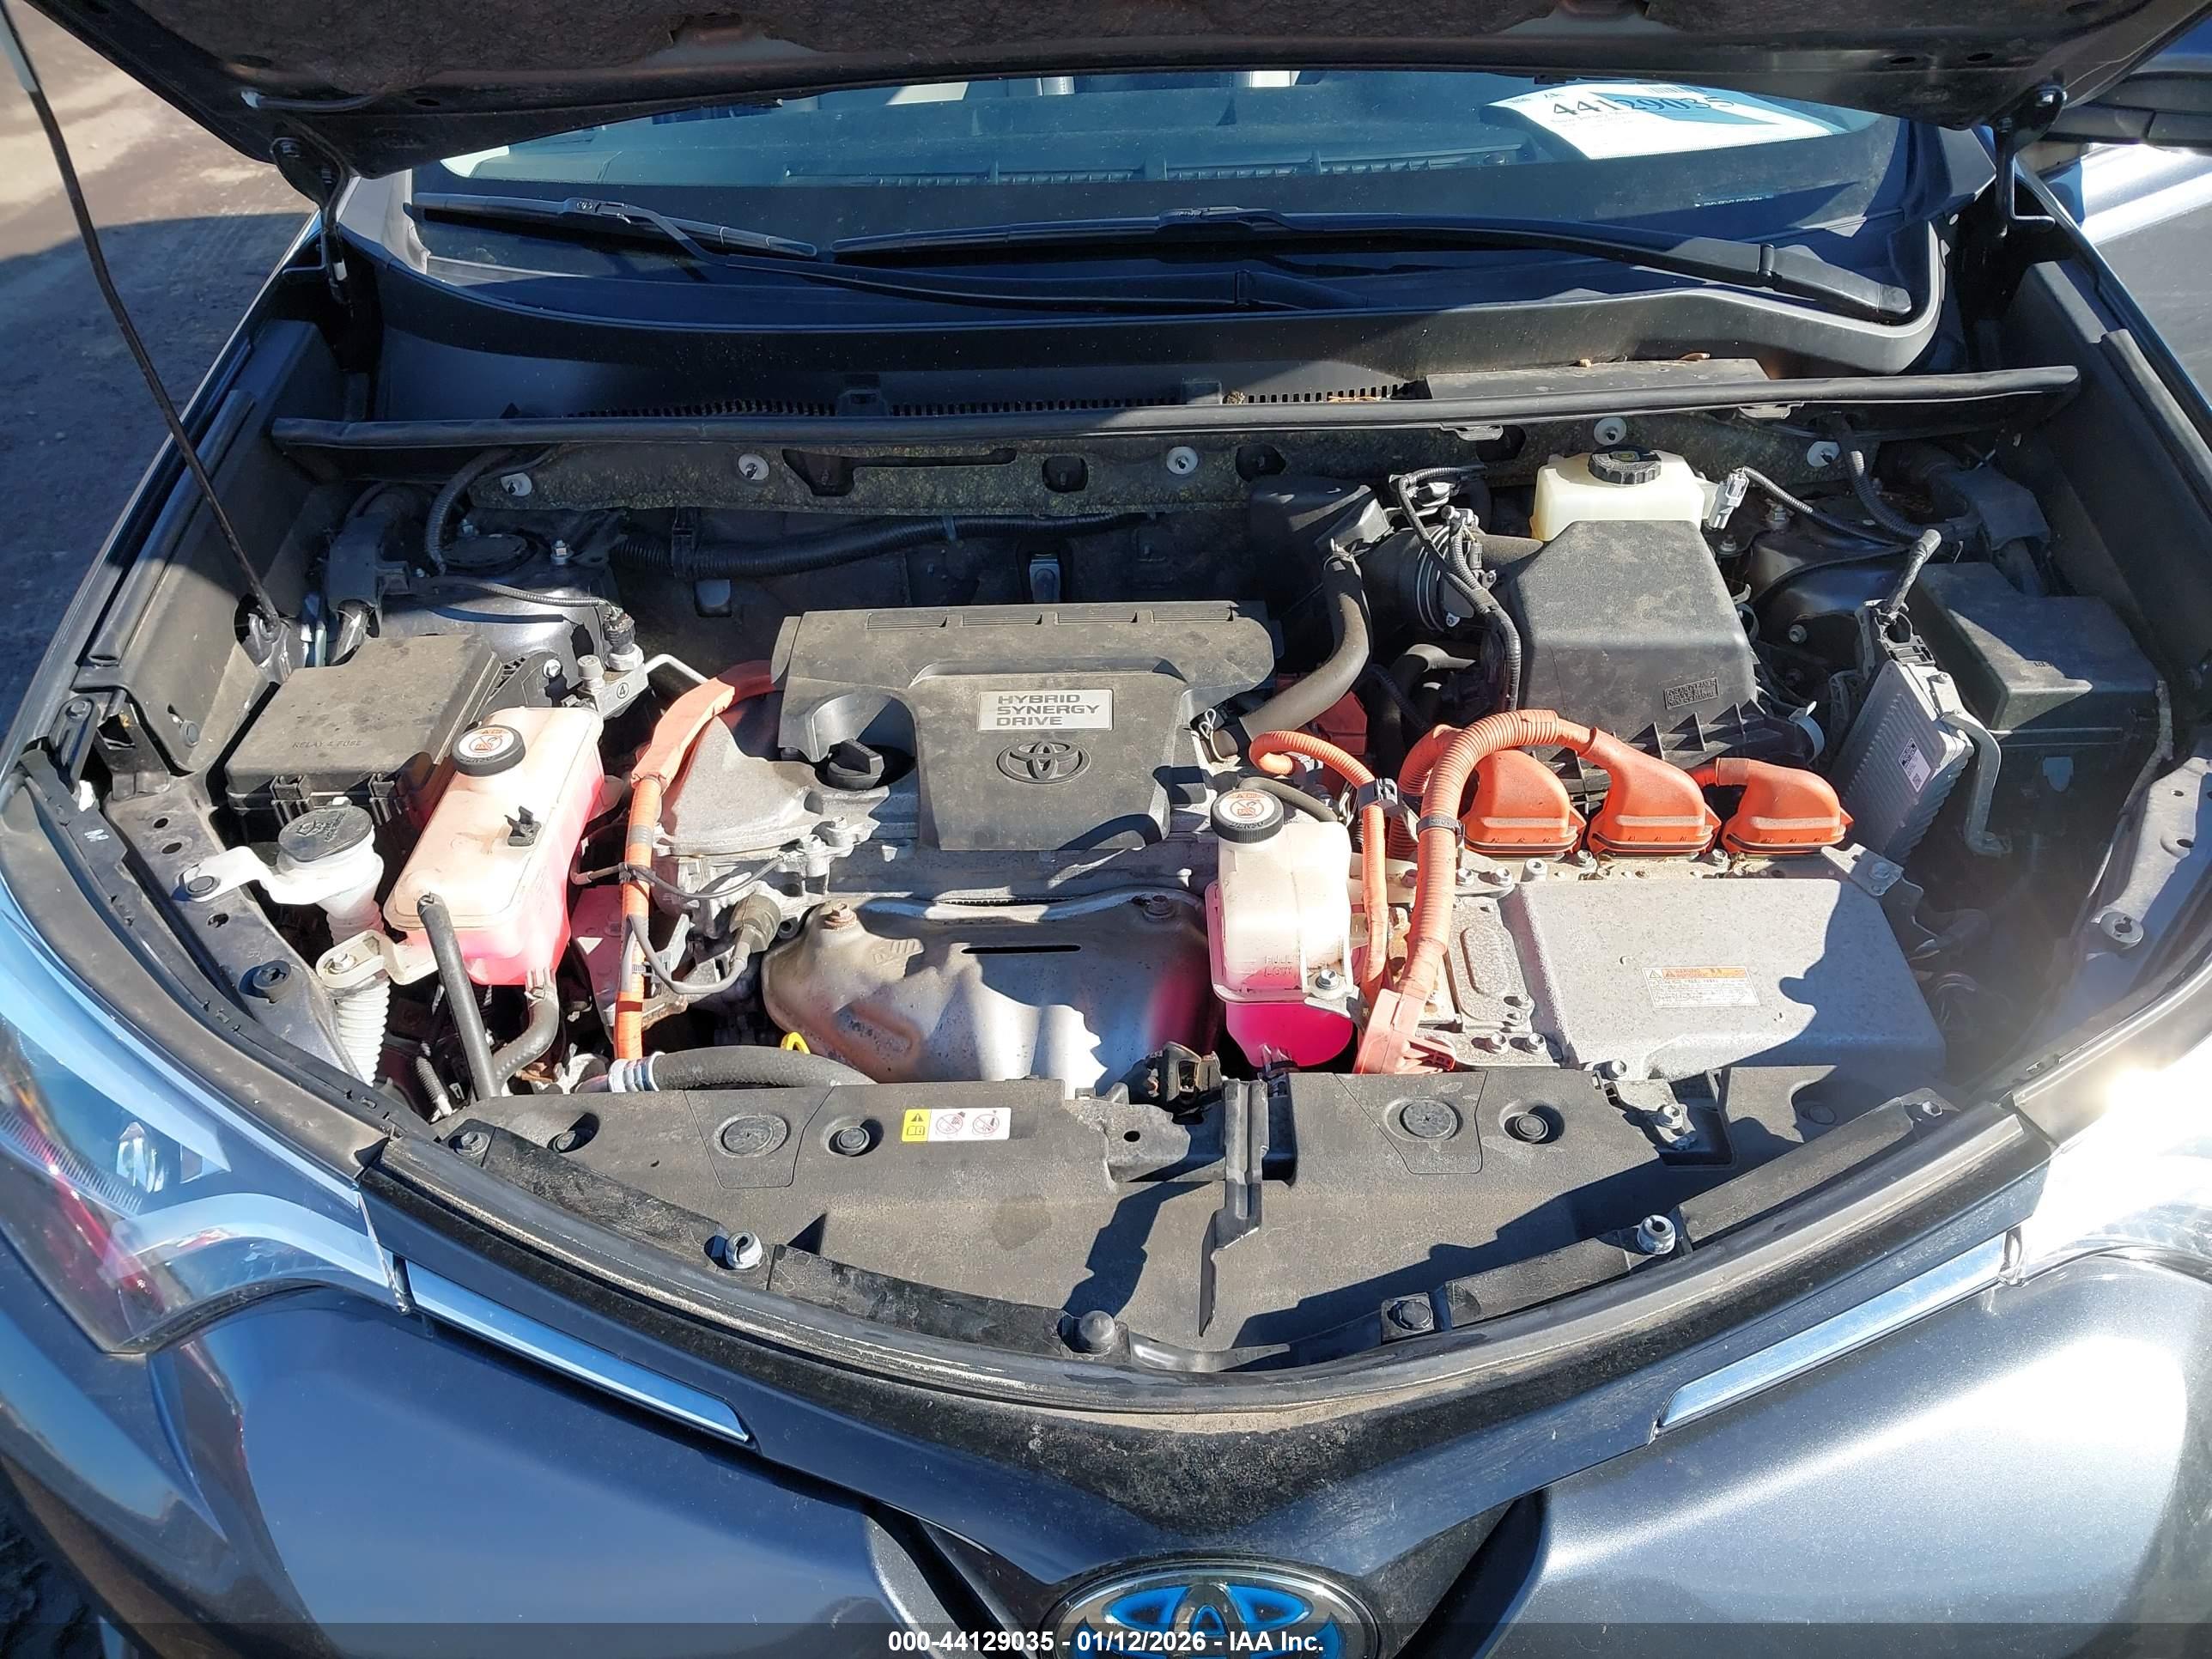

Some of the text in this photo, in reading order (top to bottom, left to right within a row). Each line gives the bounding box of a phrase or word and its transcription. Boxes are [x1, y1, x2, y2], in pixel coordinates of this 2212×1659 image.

[1553, 96, 1735, 115] 44129035
[998, 695, 1080, 704] HYBRID
[996, 705, 1100, 715] SYNERGY
[996, 716, 1063, 726] DRIVE
[1264, 955, 1292, 963] FULL
